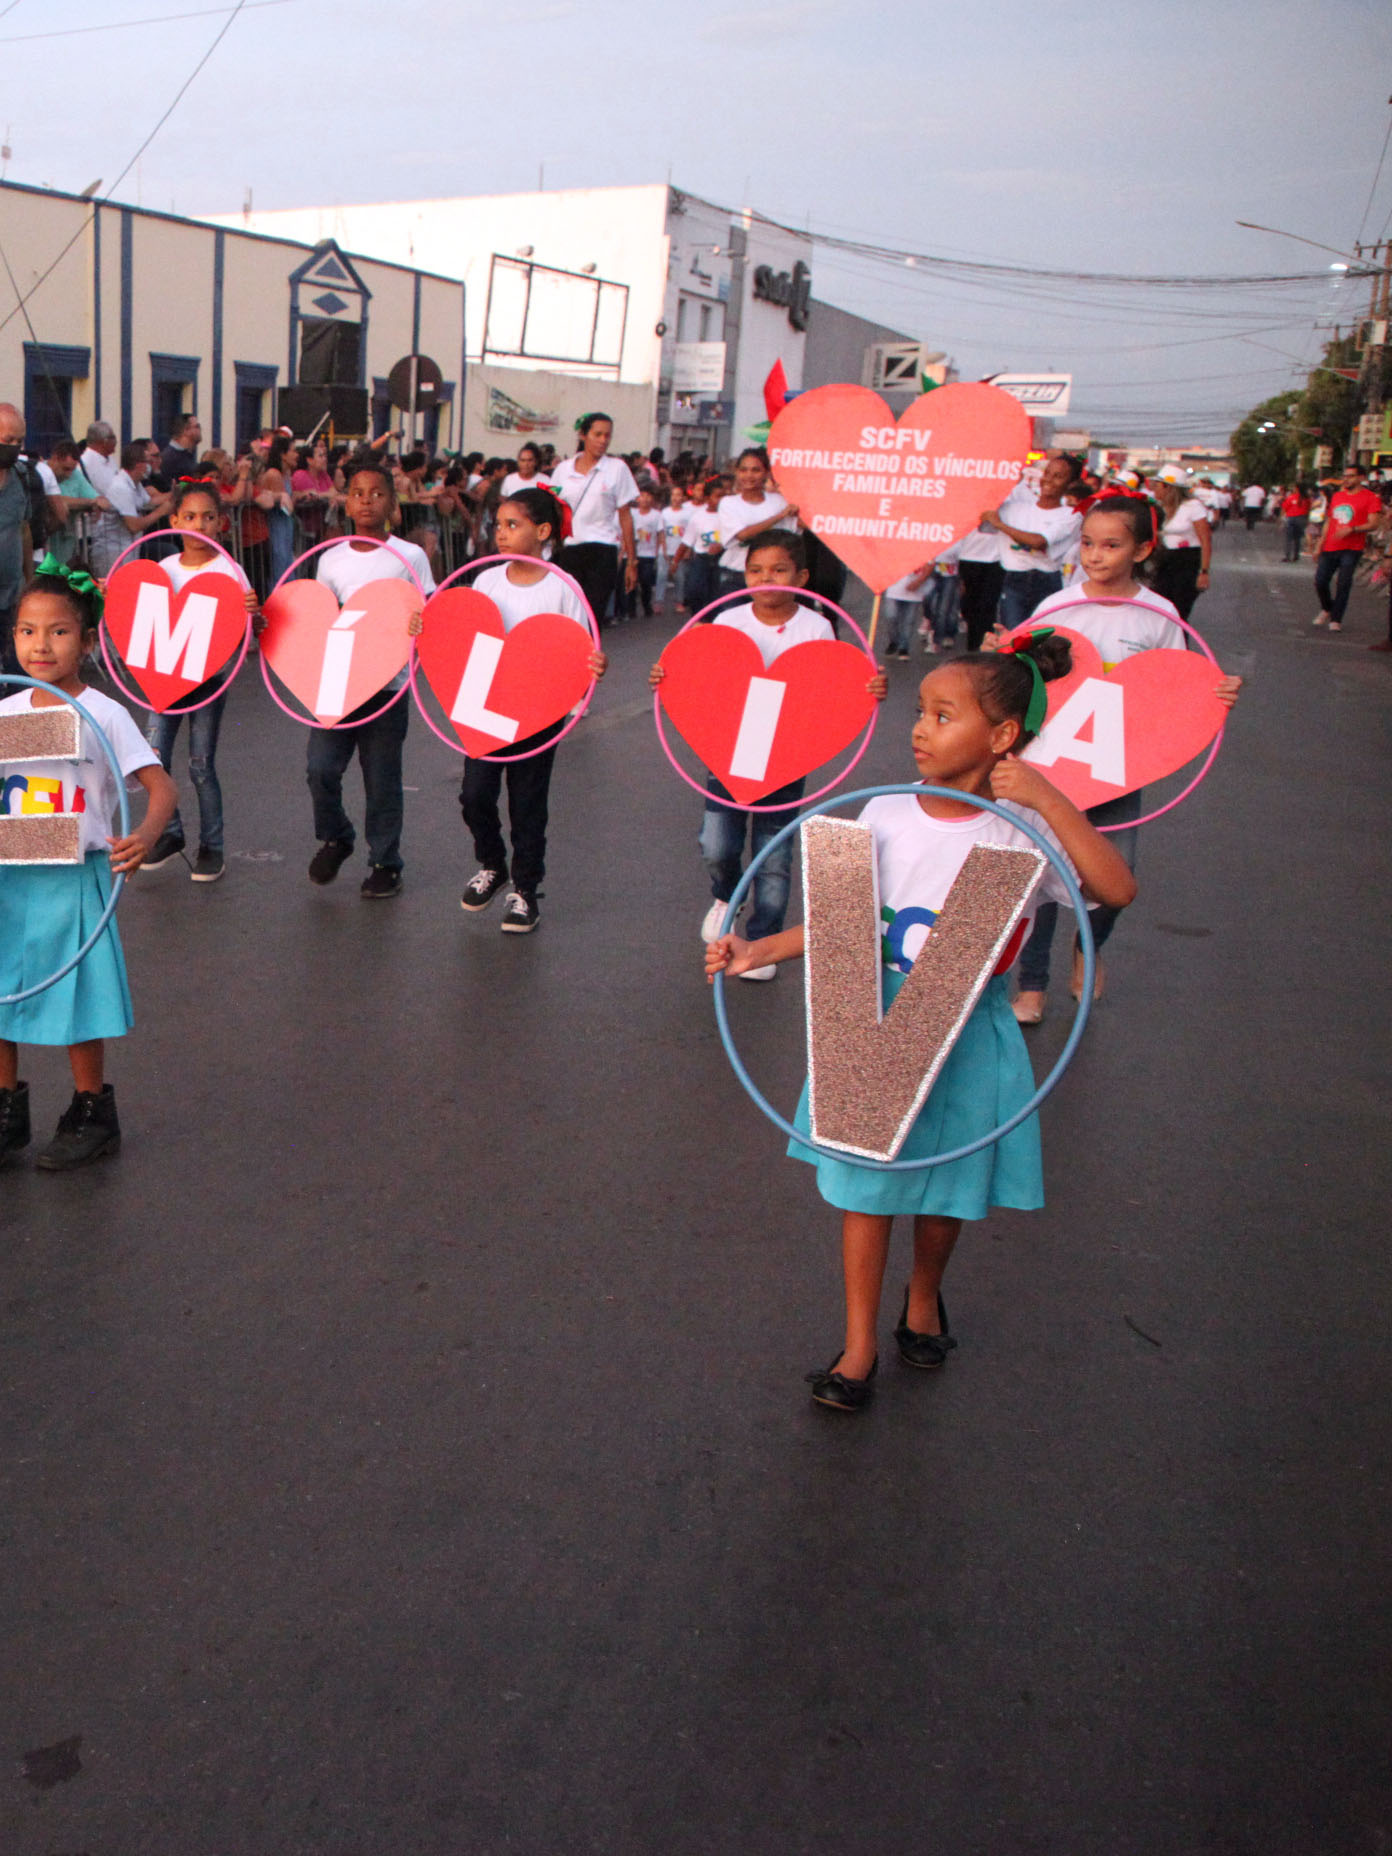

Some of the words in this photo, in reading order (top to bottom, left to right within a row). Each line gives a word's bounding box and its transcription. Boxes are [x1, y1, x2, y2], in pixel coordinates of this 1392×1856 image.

[770, 448, 900, 474] FORTALECENDO
[904, 456, 929, 475] OS
[933, 453, 1023, 481] VÍNCULOS
[859, 427, 932, 451] SCFV
[832, 473, 947, 498] FAMILIARES
[879, 498, 892, 517] E
[811, 514, 955, 543] COMUNITÁRIOS
[126, 582, 219, 683] M
[451, 632, 519, 743] L
[729, 677, 787, 781] I
[1021, 677, 1126, 787] A
[801, 815, 1049, 1162] V
